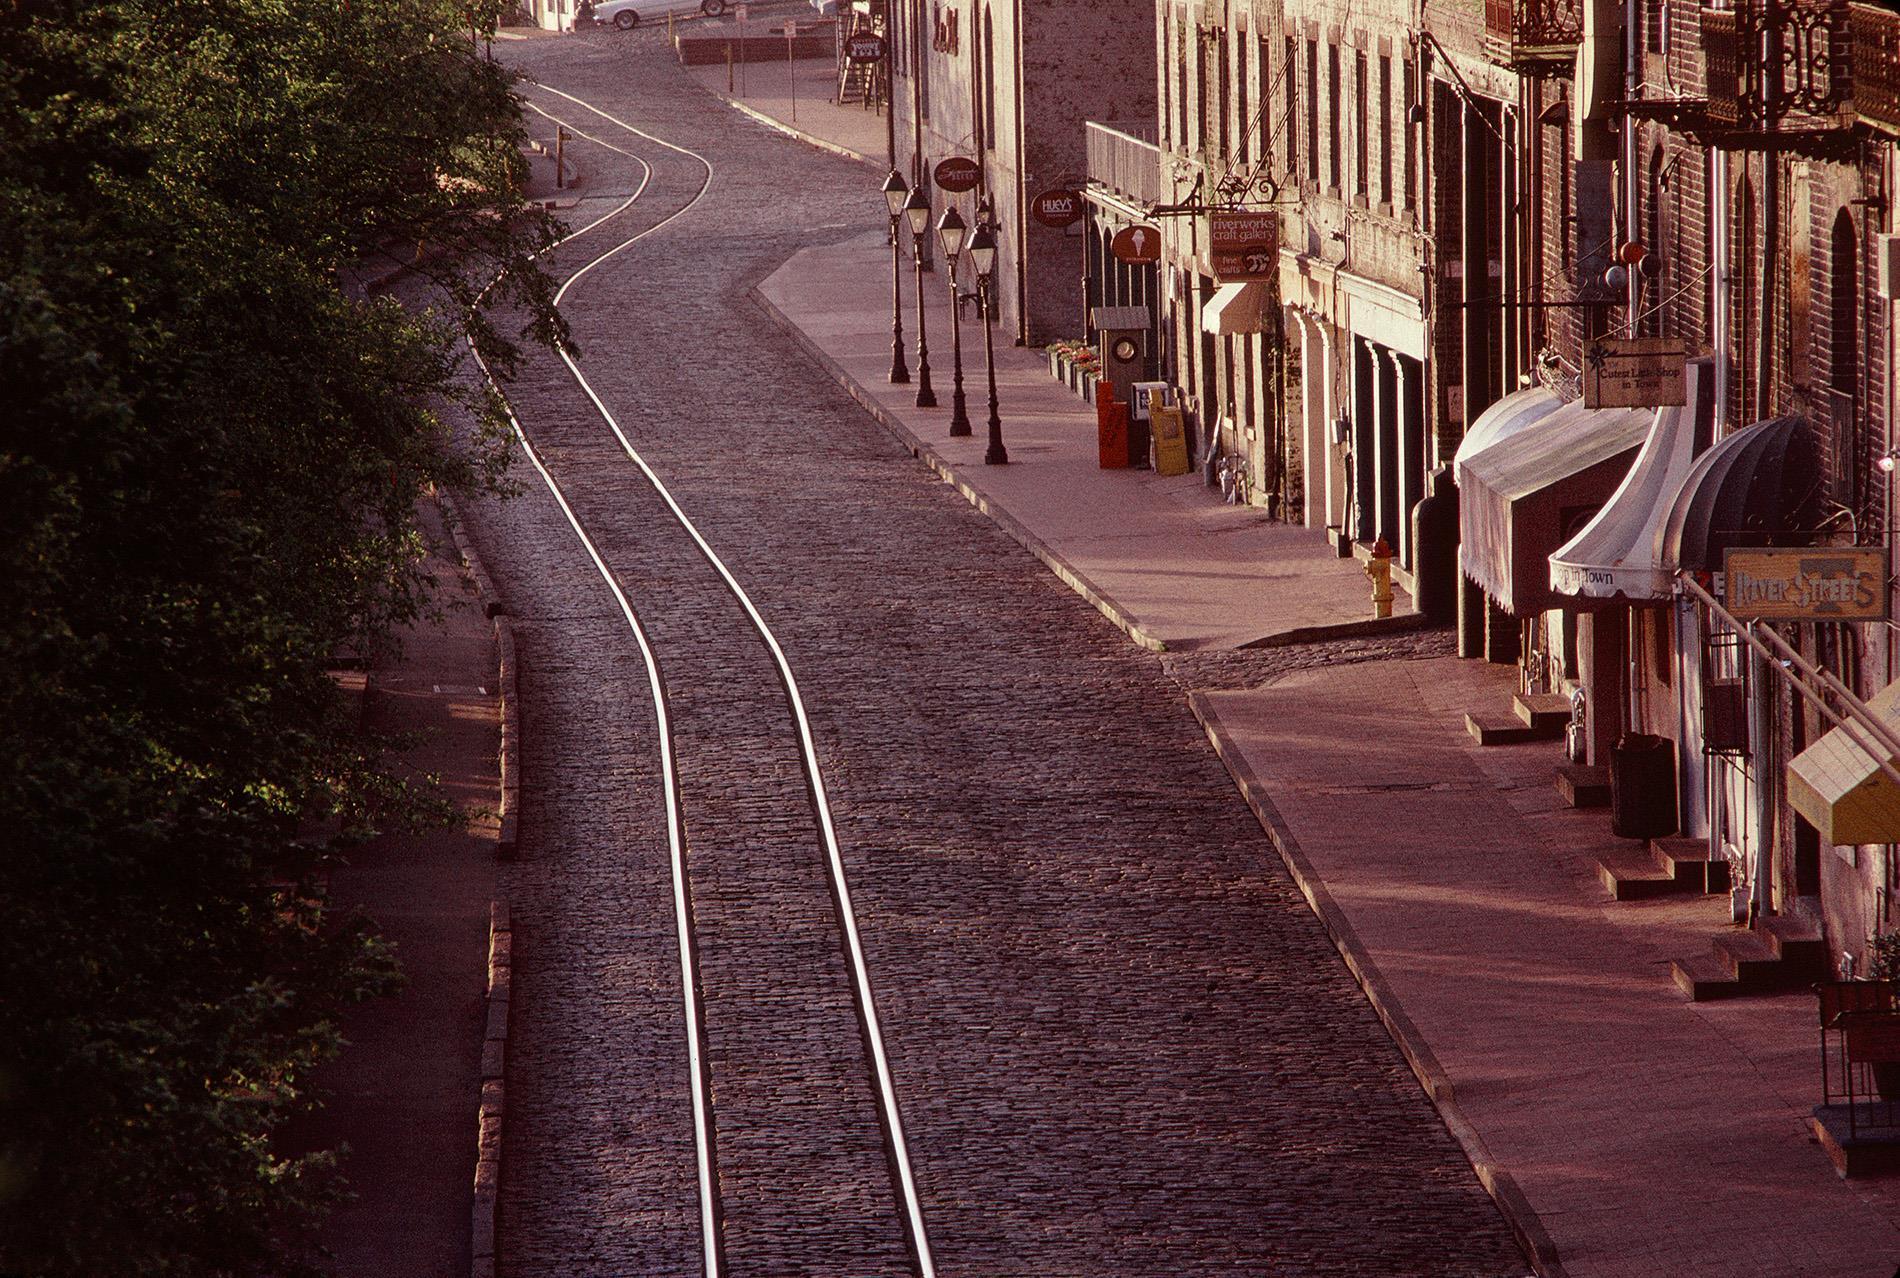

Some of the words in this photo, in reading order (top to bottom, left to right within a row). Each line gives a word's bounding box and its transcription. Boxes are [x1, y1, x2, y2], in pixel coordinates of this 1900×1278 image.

[1042, 198, 1072, 212] HUEY'S
[1213, 218, 1275, 230] riverworks
[1213, 229, 1237, 240] craft
[1239, 228, 1274, 242] gallery
[1222, 256, 1238, 265] fine
[1600, 368, 1630, 379] Cutest
[1656, 367, 1680, 378] Shop
[1582, 568, 1614, 585] Town
[1735, 572, 1789, 608] RIVER
